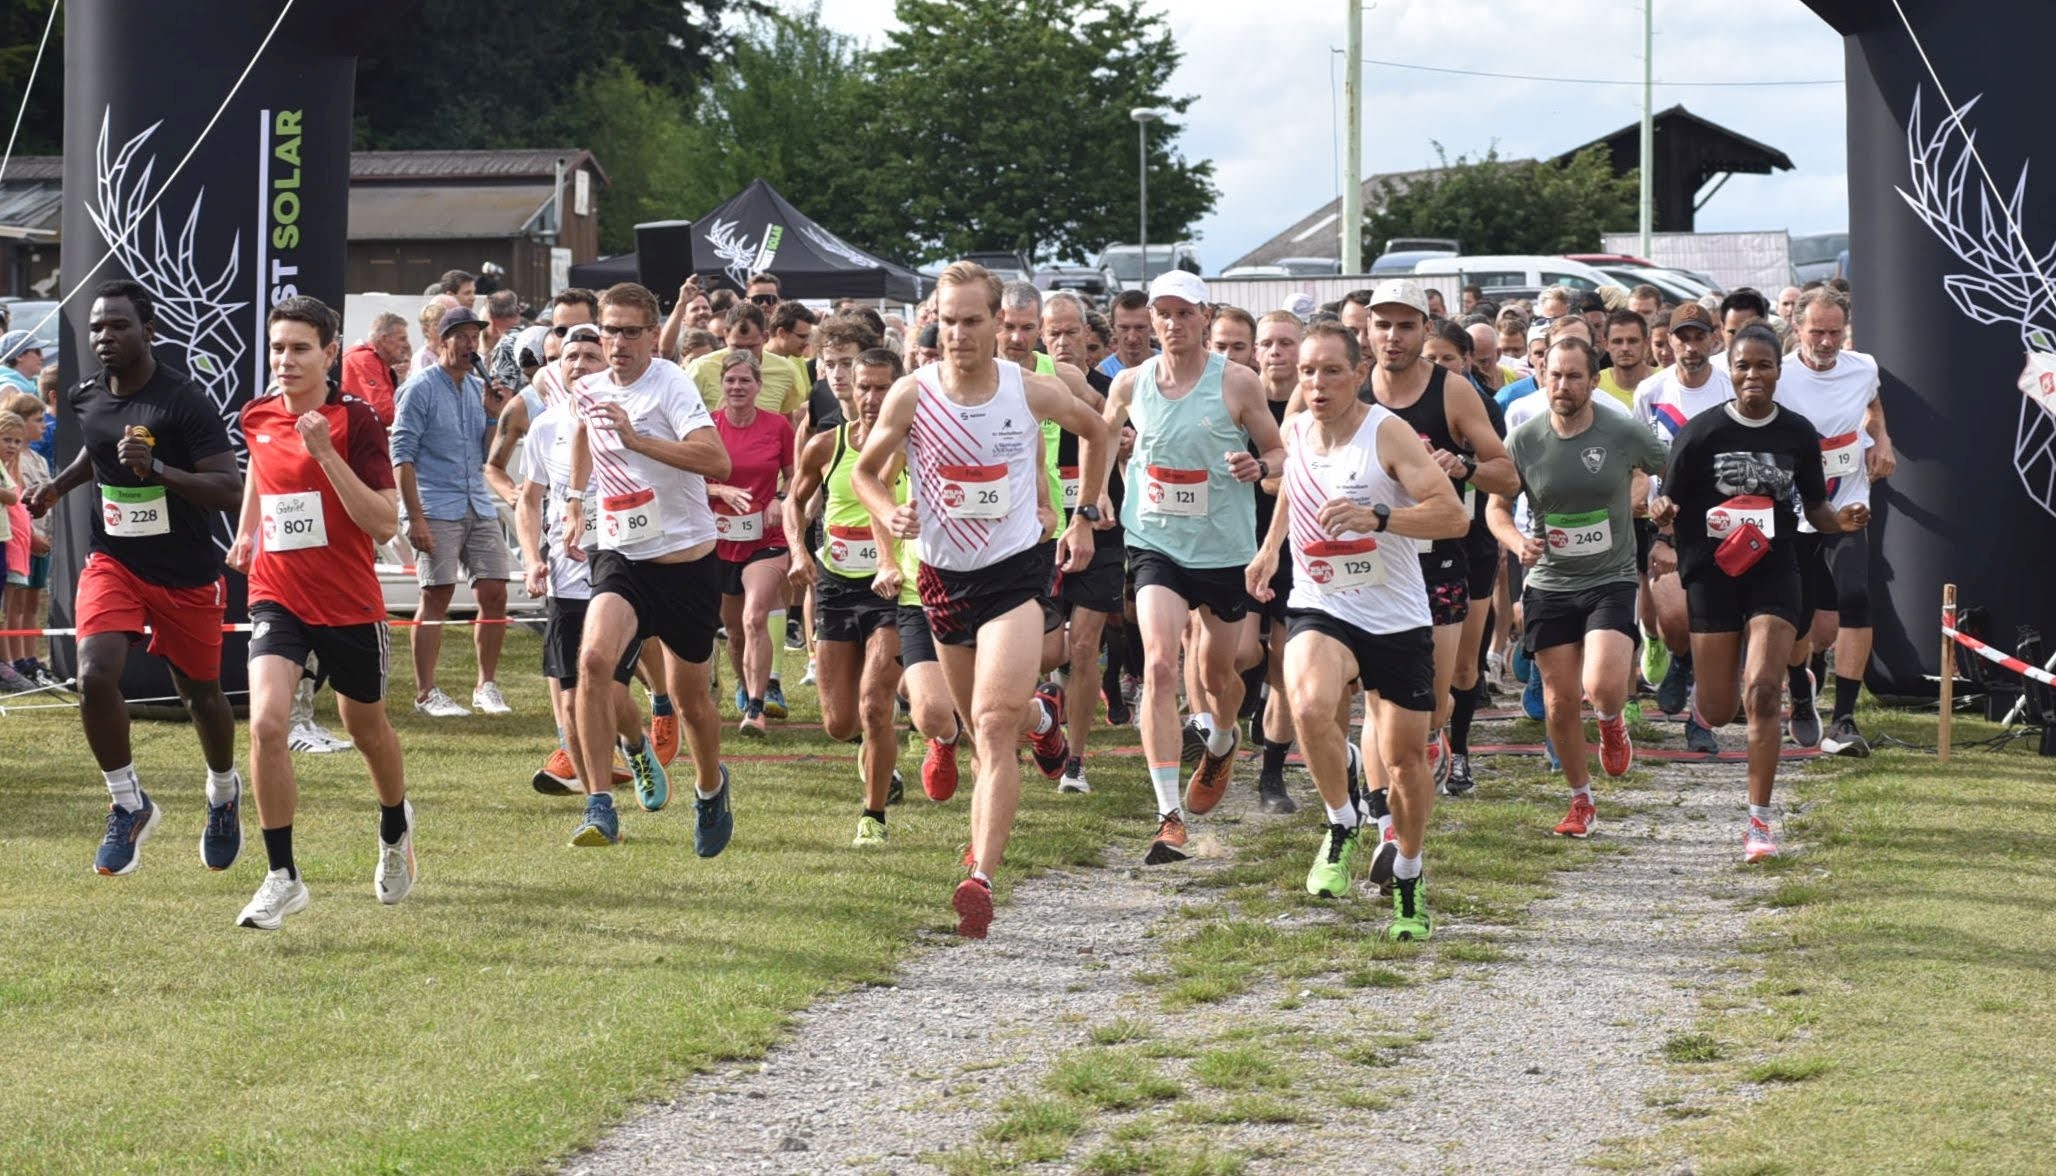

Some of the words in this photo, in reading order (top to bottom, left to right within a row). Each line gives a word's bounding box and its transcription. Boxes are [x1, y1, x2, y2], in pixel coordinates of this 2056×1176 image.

[273, 109, 303, 249] SOLAR
[271, 259, 299, 308] ST
[1839, 453, 1850, 464] 19
[978, 490, 999, 504] 26
[1176, 491, 1195, 503] 121
[130, 509, 158, 523] 228
[628, 515, 648, 529] 80
[284, 519, 314, 534] 807
[742, 520, 753, 530] 15
[1575, 531, 1603, 545] 240
[859, 548, 877, 559] 46
[1344, 561, 1371, 575] 129
